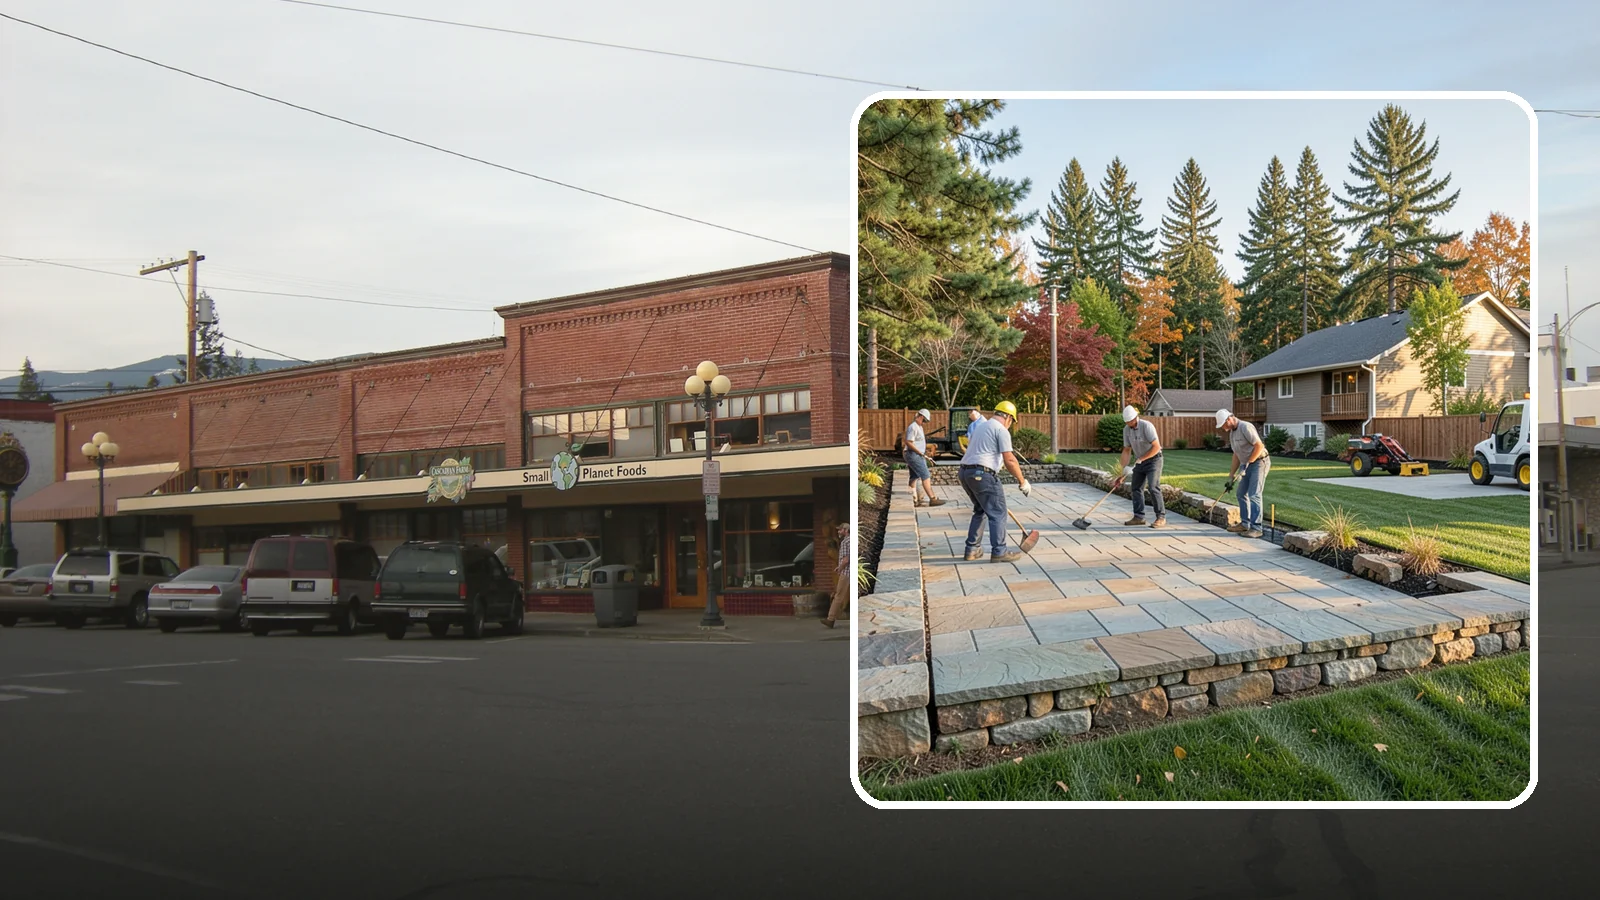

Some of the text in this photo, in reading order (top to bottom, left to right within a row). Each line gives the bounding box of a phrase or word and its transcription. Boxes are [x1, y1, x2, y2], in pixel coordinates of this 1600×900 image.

[523, 464, 647, 483] Small Planet Foods
